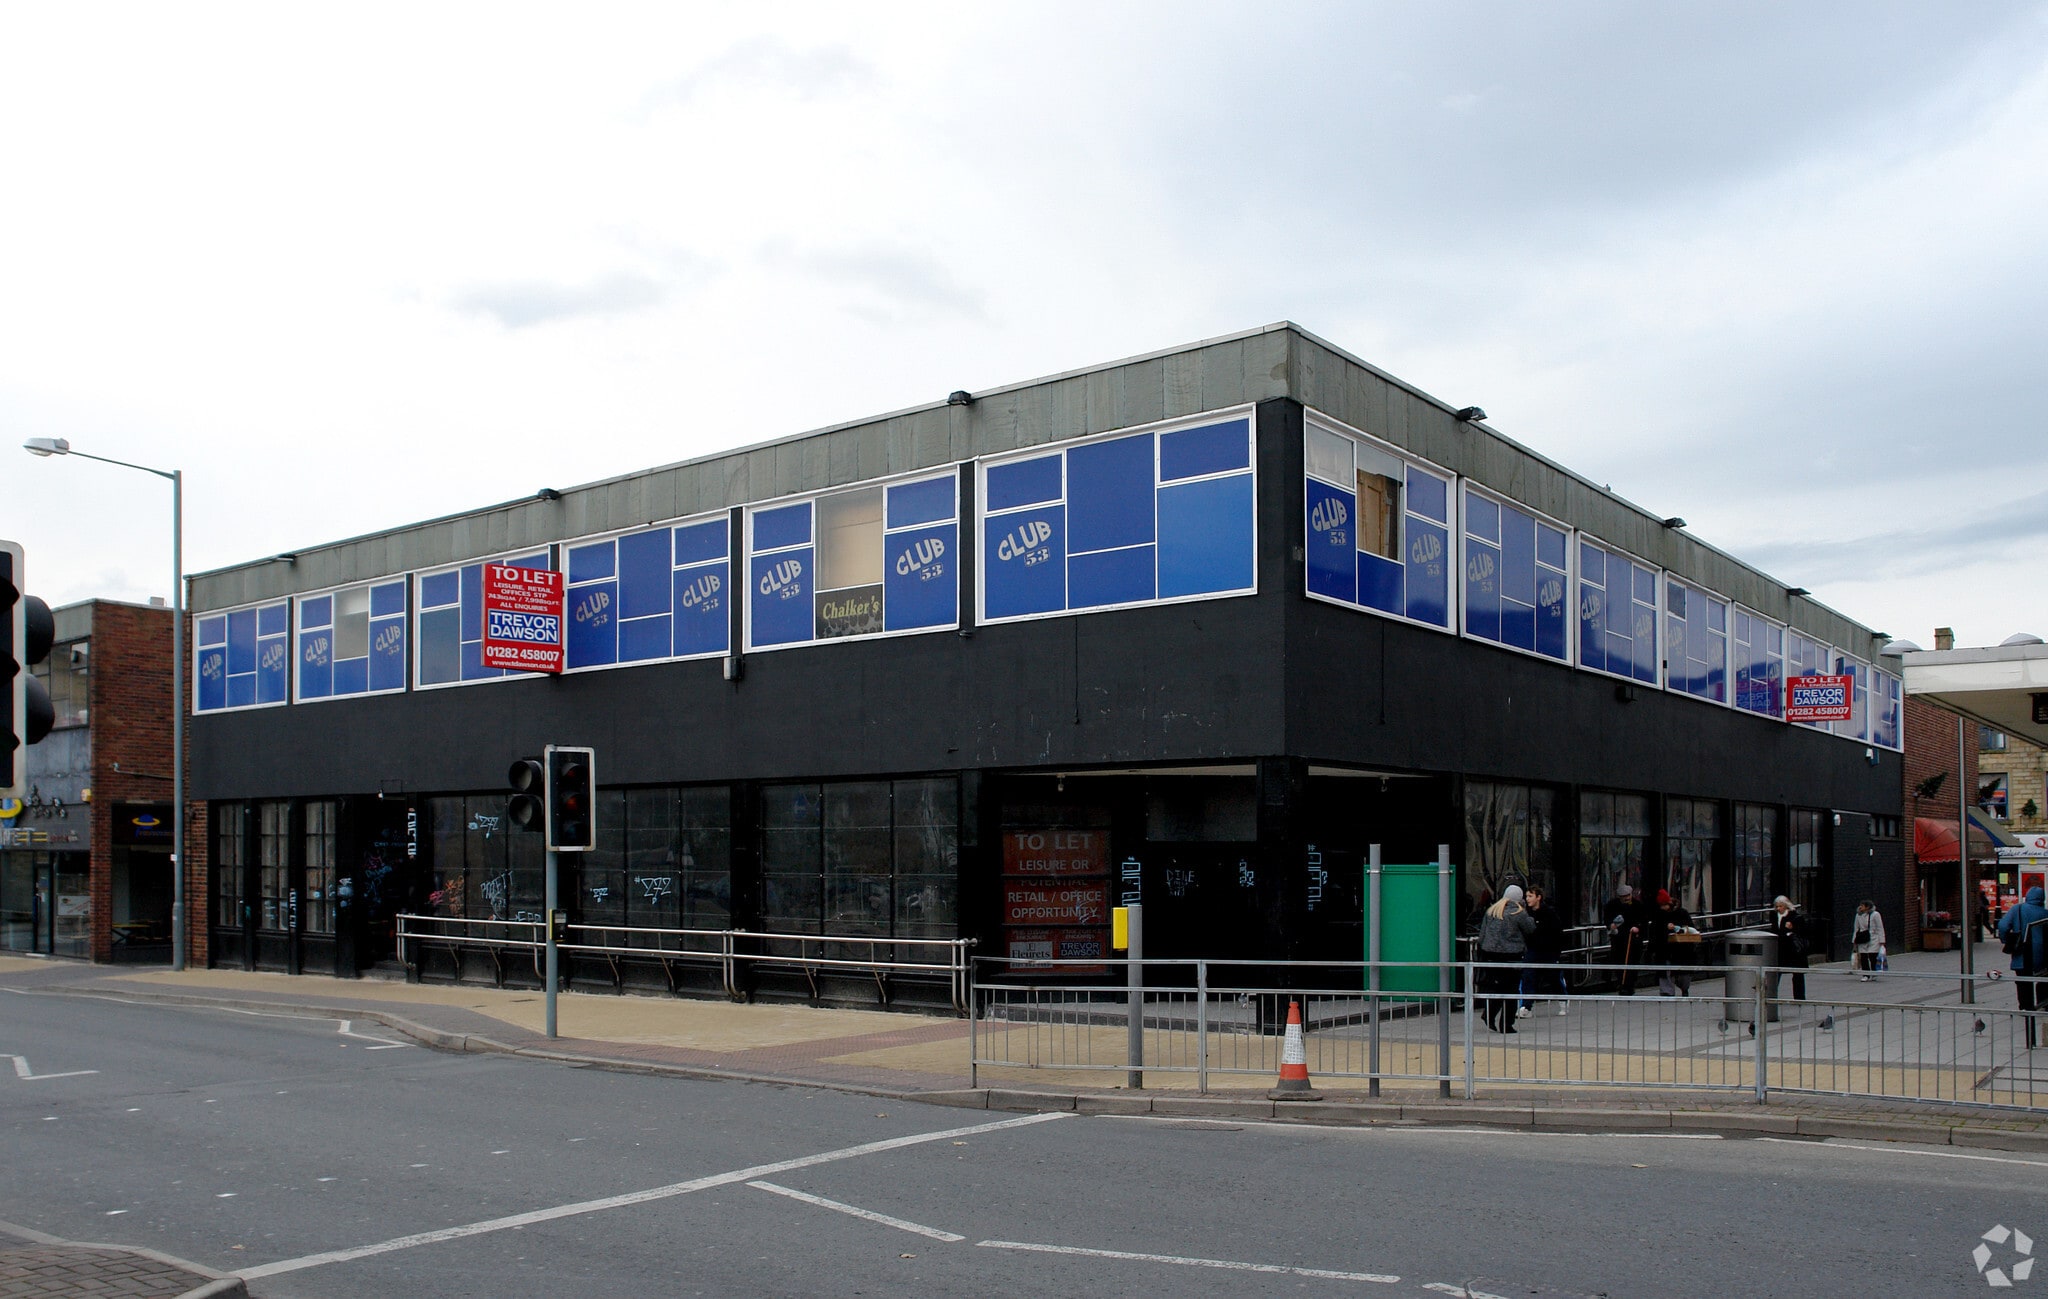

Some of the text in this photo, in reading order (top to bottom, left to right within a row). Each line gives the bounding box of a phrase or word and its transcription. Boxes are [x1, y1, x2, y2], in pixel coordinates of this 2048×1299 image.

[1311, 497, 1347, 532] CLUB
[998, 521, 1052, 561] CLUB
[1330, 531, 1347, 545] 53
[896, 538, 945, 576] CLUB
[1025, 547, 1049, 566] 53
[1411, 533, 1441, 564] CLUB
[921, 563, 943, 581] 53
[1427, 563, 1440, 576] 53
[1467, 552, 1494, 582] CLUB
[492, 566, 556, 586] TO LET
[759, 559, 802, 595] CLUB
[501, 588, 531, 597] OFFICES
[682, 575, 721, 607] CLUB
[781, 582, 800, 599] 53
[1481, 581, 1493, 592] 53
[1540, 580, 1562, 608] CLUB
[514, 603, 548, 611] ENQUIRIES
[576, 592, 609, 622] CLUB
[702, 598, 719, 612] 53
[823, 596, 880, 620] Chalker's
[1551, 605, 1561, 616] 53
[1581, 592, 1600, 620] CLUB
[490, 612, 556, 630] TREVOR
[592, 614, 608, 627] 53
[375, 625, 401, 651] CLUB
[490, 624, 557, 641] DAWSON
[262, 644, 284, 668] CLUB
[305, 637, 328, 662] CLUB
[486, 646, 560, 662] 01282 458007
[202, 653, 222, 677] CLUB
[1795, 688, 1843, 697] TREVOR
[1795, 697, 1843, 705] DAWSON
[1788, 708, 1814, 716] 01282
[1815, 707, 1850, 715] 458007
[1015, 833, 1093, 850] TO LET
[1019, 860, 1089, 871] LEISURE OR
[1020, 878, 1088, 887] POTENTIAL
[1008, 890, 1102, 903] RETAIL / OFFICE
[1012, 907, 1098, 918] OPPORTUNITY
[1012, 950, 1050, 959] Fleurets
[1061, 942, 1100, 950] TREVOR
